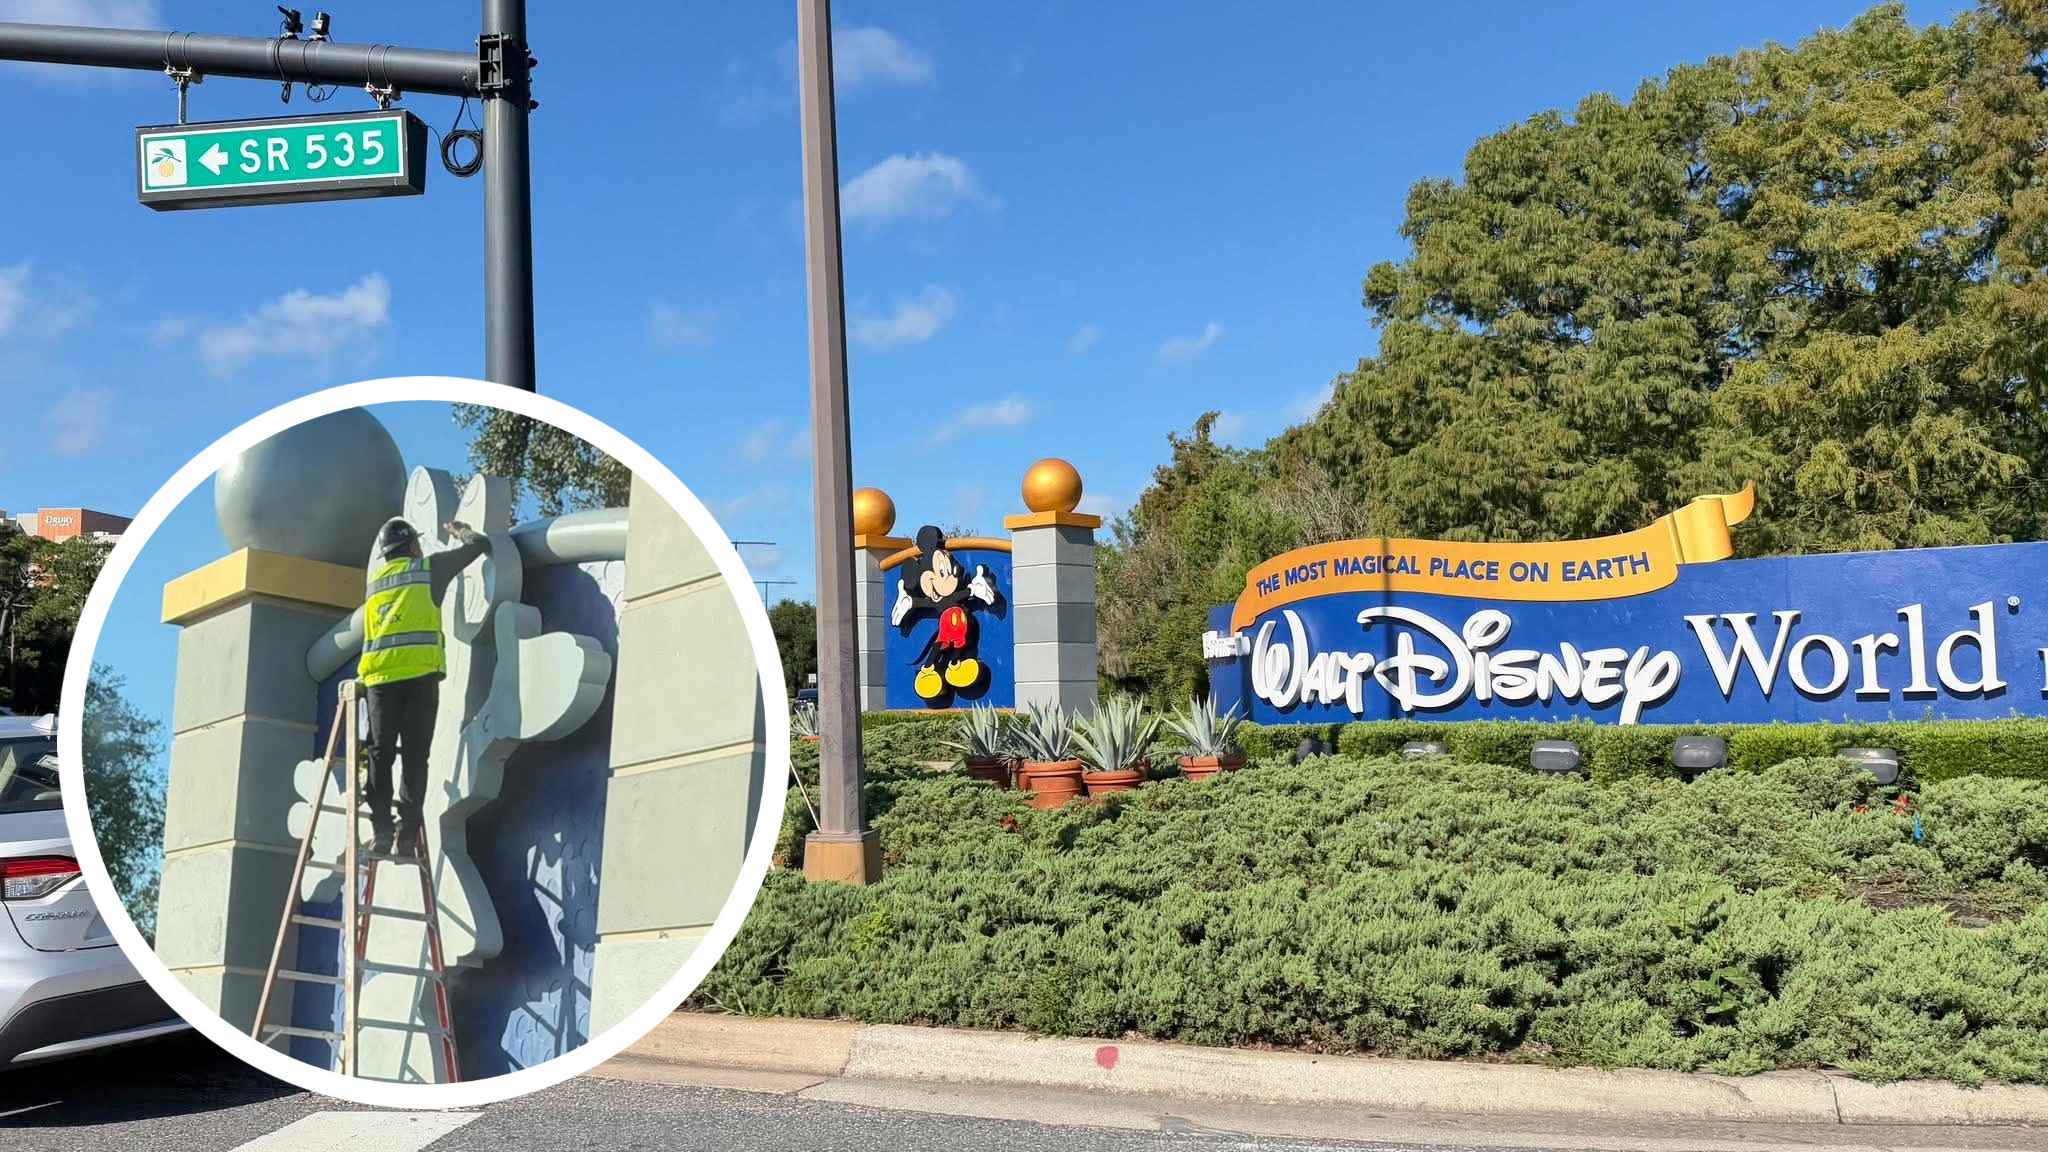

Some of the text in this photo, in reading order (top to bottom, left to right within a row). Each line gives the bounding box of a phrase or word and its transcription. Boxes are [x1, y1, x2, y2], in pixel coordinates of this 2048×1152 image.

[239, 130, 384, 173] SR 535
[1256, 552, 1650, 597] THE MOST MAGICAL PLACE ON EARTH
